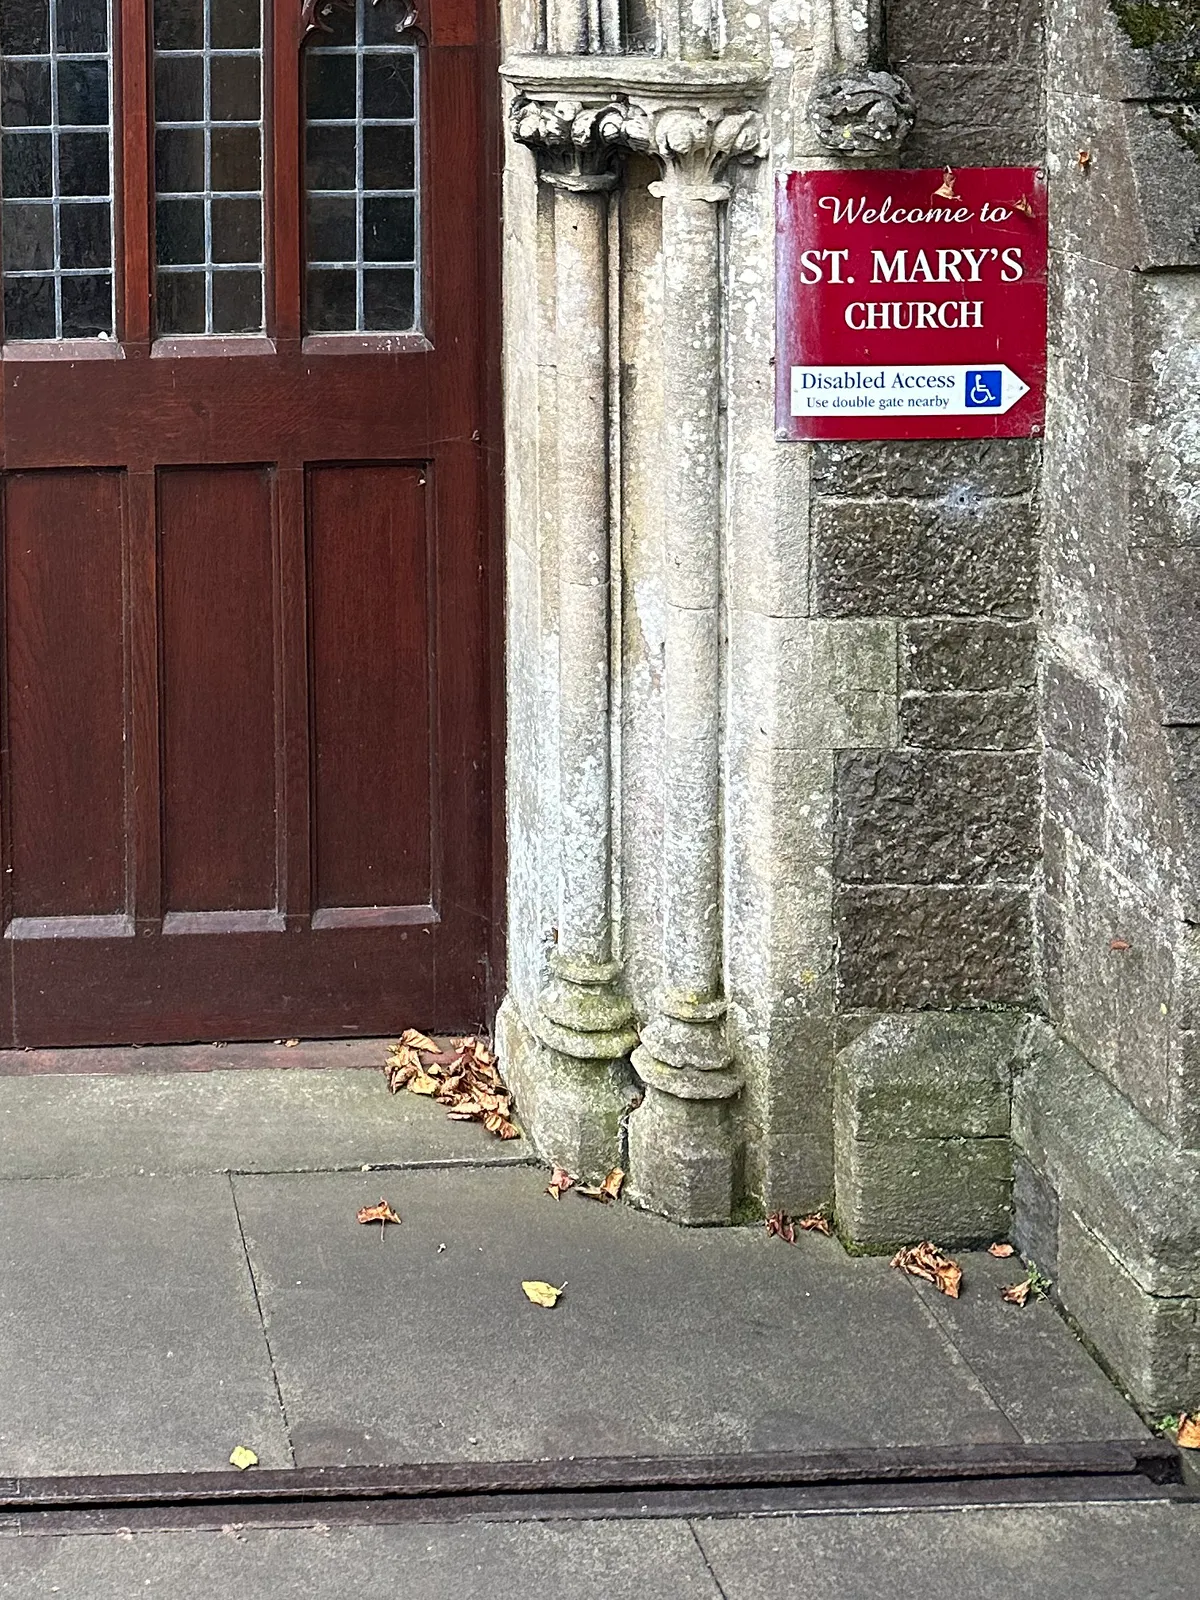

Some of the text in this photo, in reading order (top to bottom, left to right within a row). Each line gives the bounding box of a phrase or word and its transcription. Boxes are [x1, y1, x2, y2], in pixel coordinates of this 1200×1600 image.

[818, 195, 1013, 224] Welcome to
[800, 248, 1023, 285] ST. MARY'S
[844, 301, 984, 330] CHURCH
[801, 371, 956, 390] Disabled Access
[806, 396, 950, 411] Use double gate nearby
